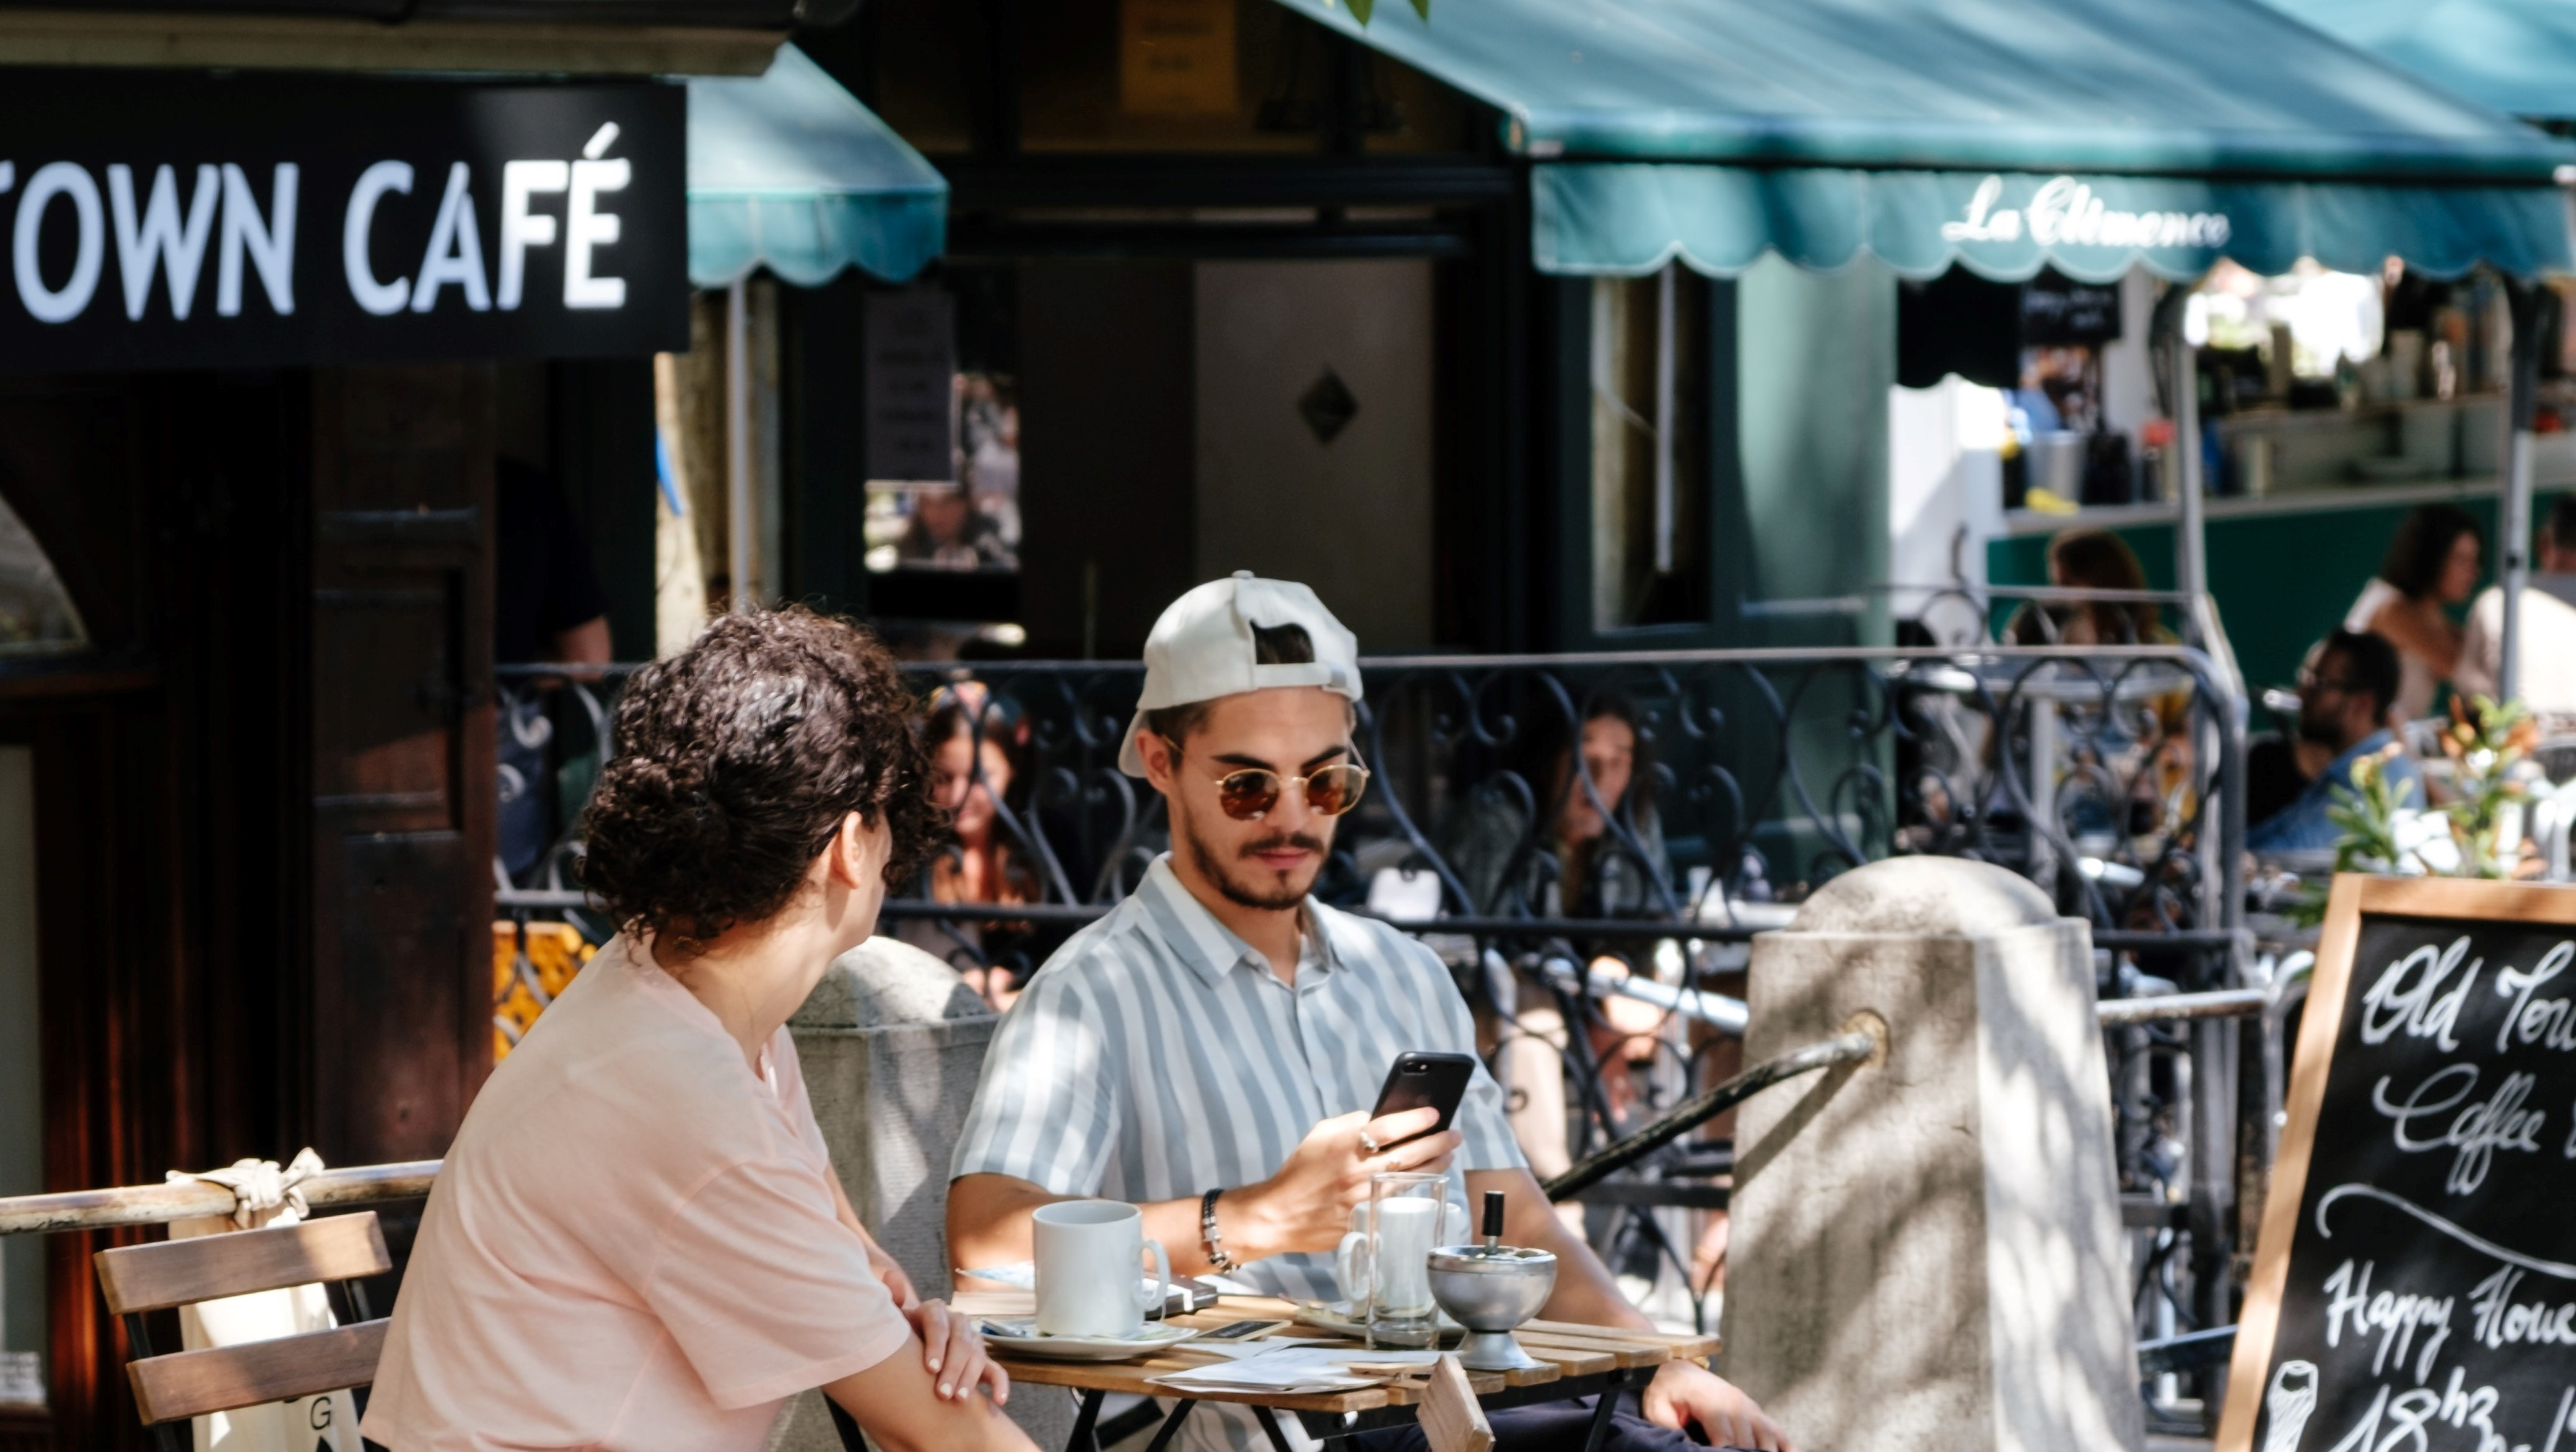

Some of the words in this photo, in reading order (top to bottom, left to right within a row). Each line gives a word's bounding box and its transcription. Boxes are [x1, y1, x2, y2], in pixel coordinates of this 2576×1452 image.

[0, 159, 300, 322] OWN
[343, 121, 631, 315] CAFÉ
[1941, 173, 2021, 242] La
[2361, 935, 2484, 1052] Old
[2372, 1062, 2546, 1194] Coffee
[2323, 1258, 2454, 1386] Happy
